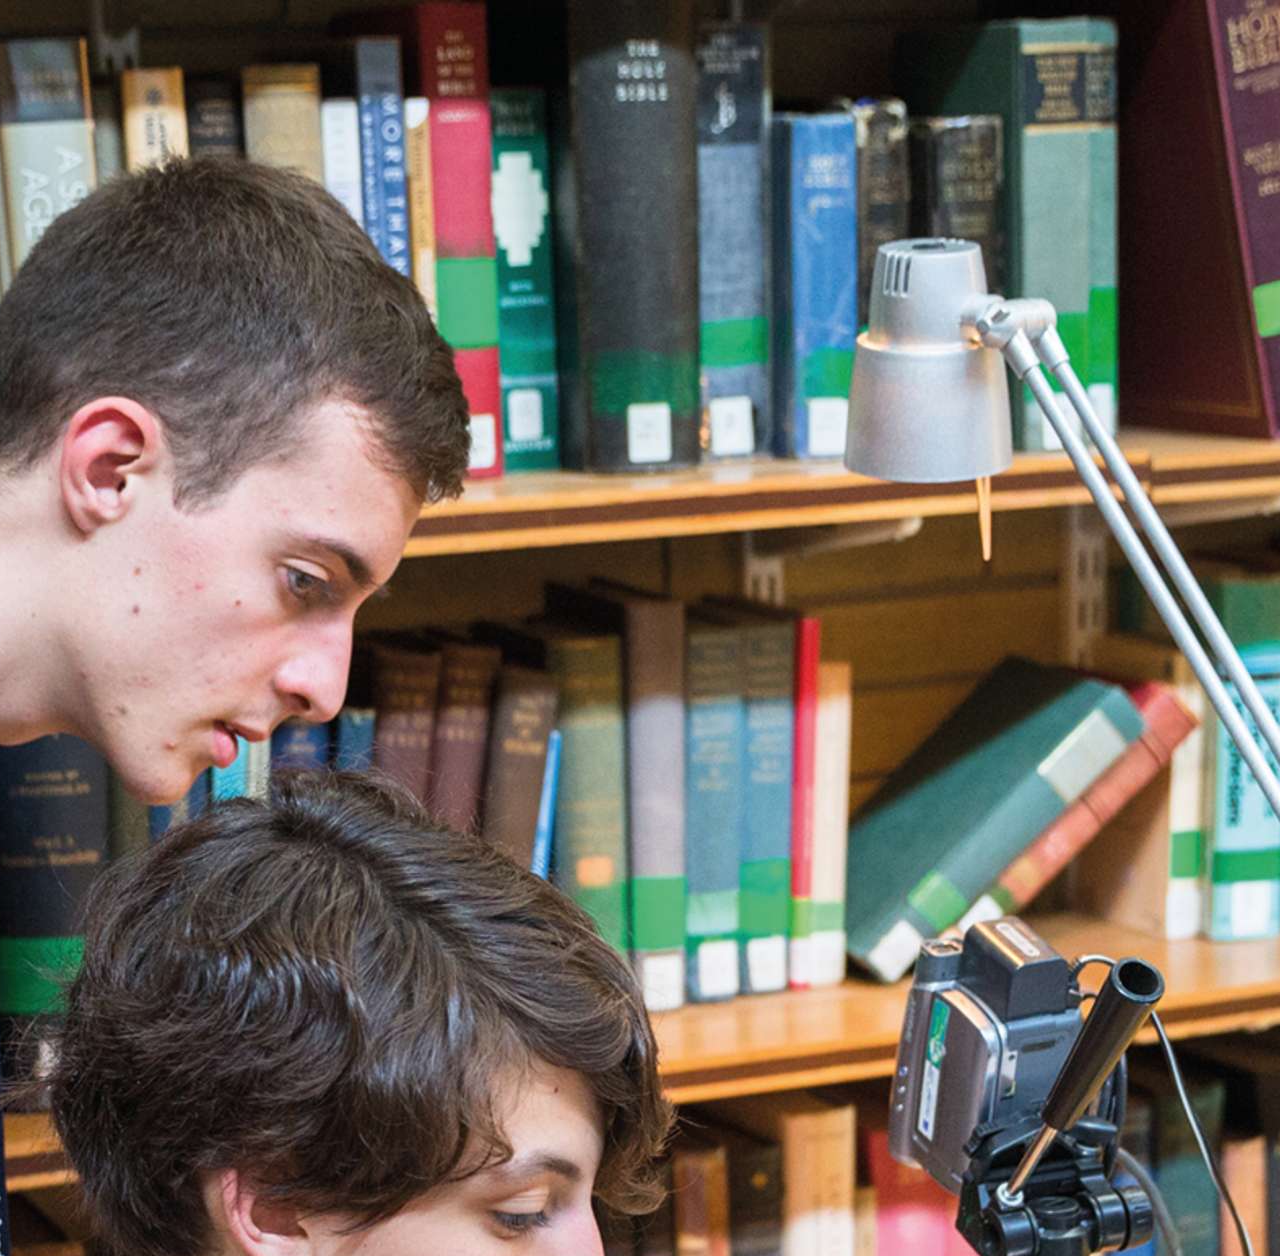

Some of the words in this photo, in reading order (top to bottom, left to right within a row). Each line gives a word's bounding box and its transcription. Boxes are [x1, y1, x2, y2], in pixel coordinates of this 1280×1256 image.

[626, 38, 659, 57] THE
[618, 61, 666, 79] HOLY
[616, 83, 667, 102] BIBLE
[381, 92, 404, 184] MORE
[55, 146, 84, 174] A
[386, 195, 410, 278] THAN
